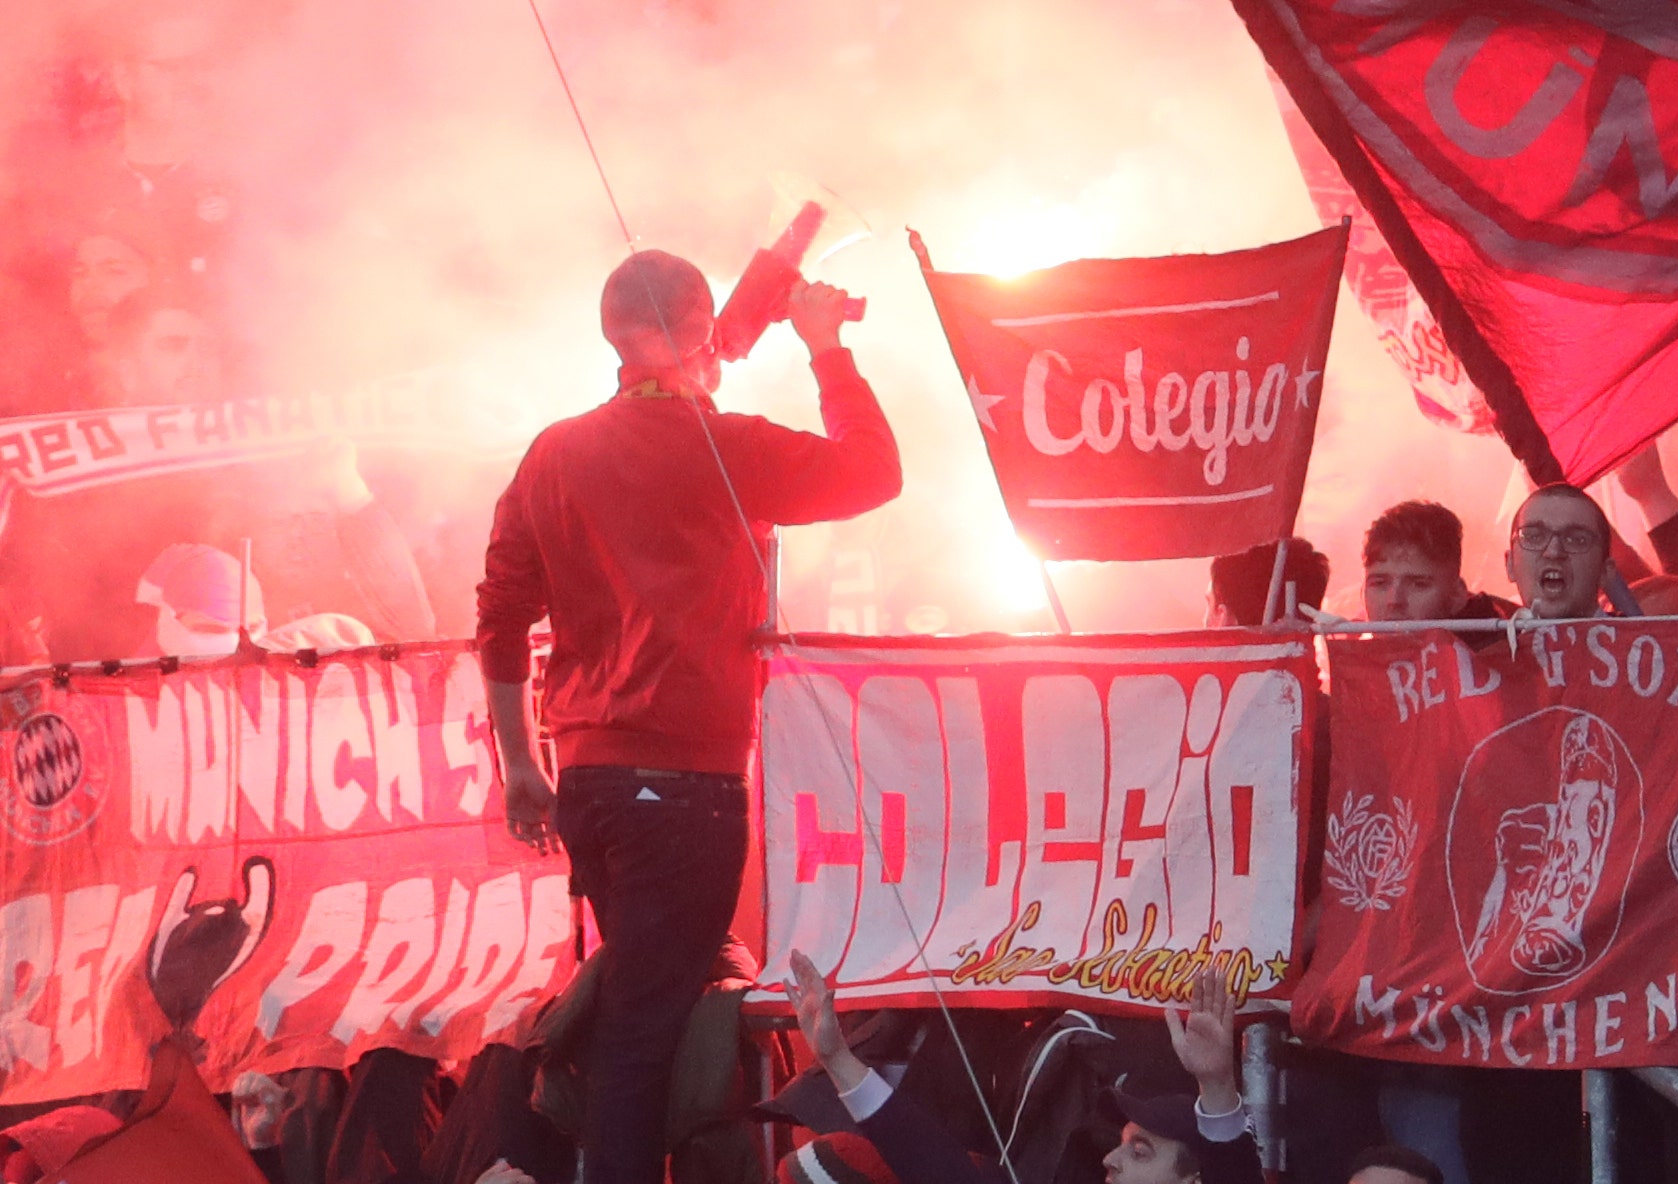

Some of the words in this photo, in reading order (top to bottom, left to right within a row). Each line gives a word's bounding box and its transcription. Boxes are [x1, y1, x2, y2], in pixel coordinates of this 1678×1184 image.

[1022, 336, 1290, 486] Colegio
[125, 662, 425, 845] MUNICH
[1387, 640, 1501, 723] RED
[254, 872, 573, 1045] PRIDE
[1355, 973, 1678, 1066] MÜNCHEN
